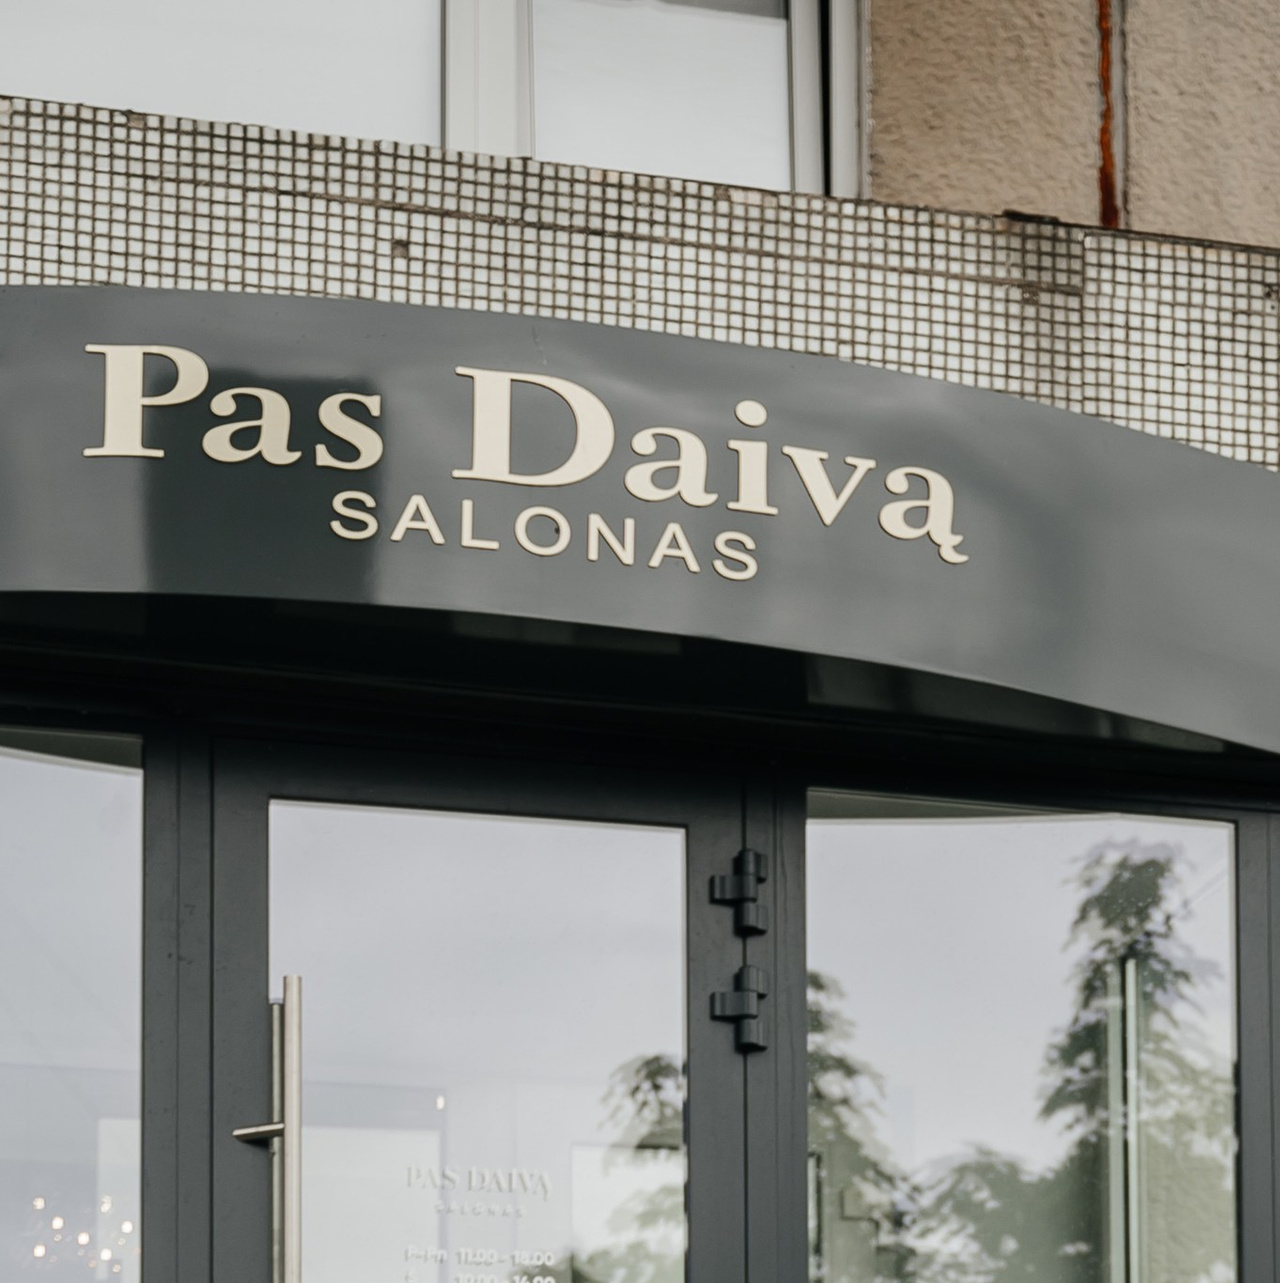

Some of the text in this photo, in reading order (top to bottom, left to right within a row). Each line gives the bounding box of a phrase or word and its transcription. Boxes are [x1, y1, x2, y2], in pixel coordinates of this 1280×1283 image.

[83, 344, 969, 563] Pas Daivą
[330, 491, 758, 580] SALONAS
[406, 1164, 460, 1192] PAS
